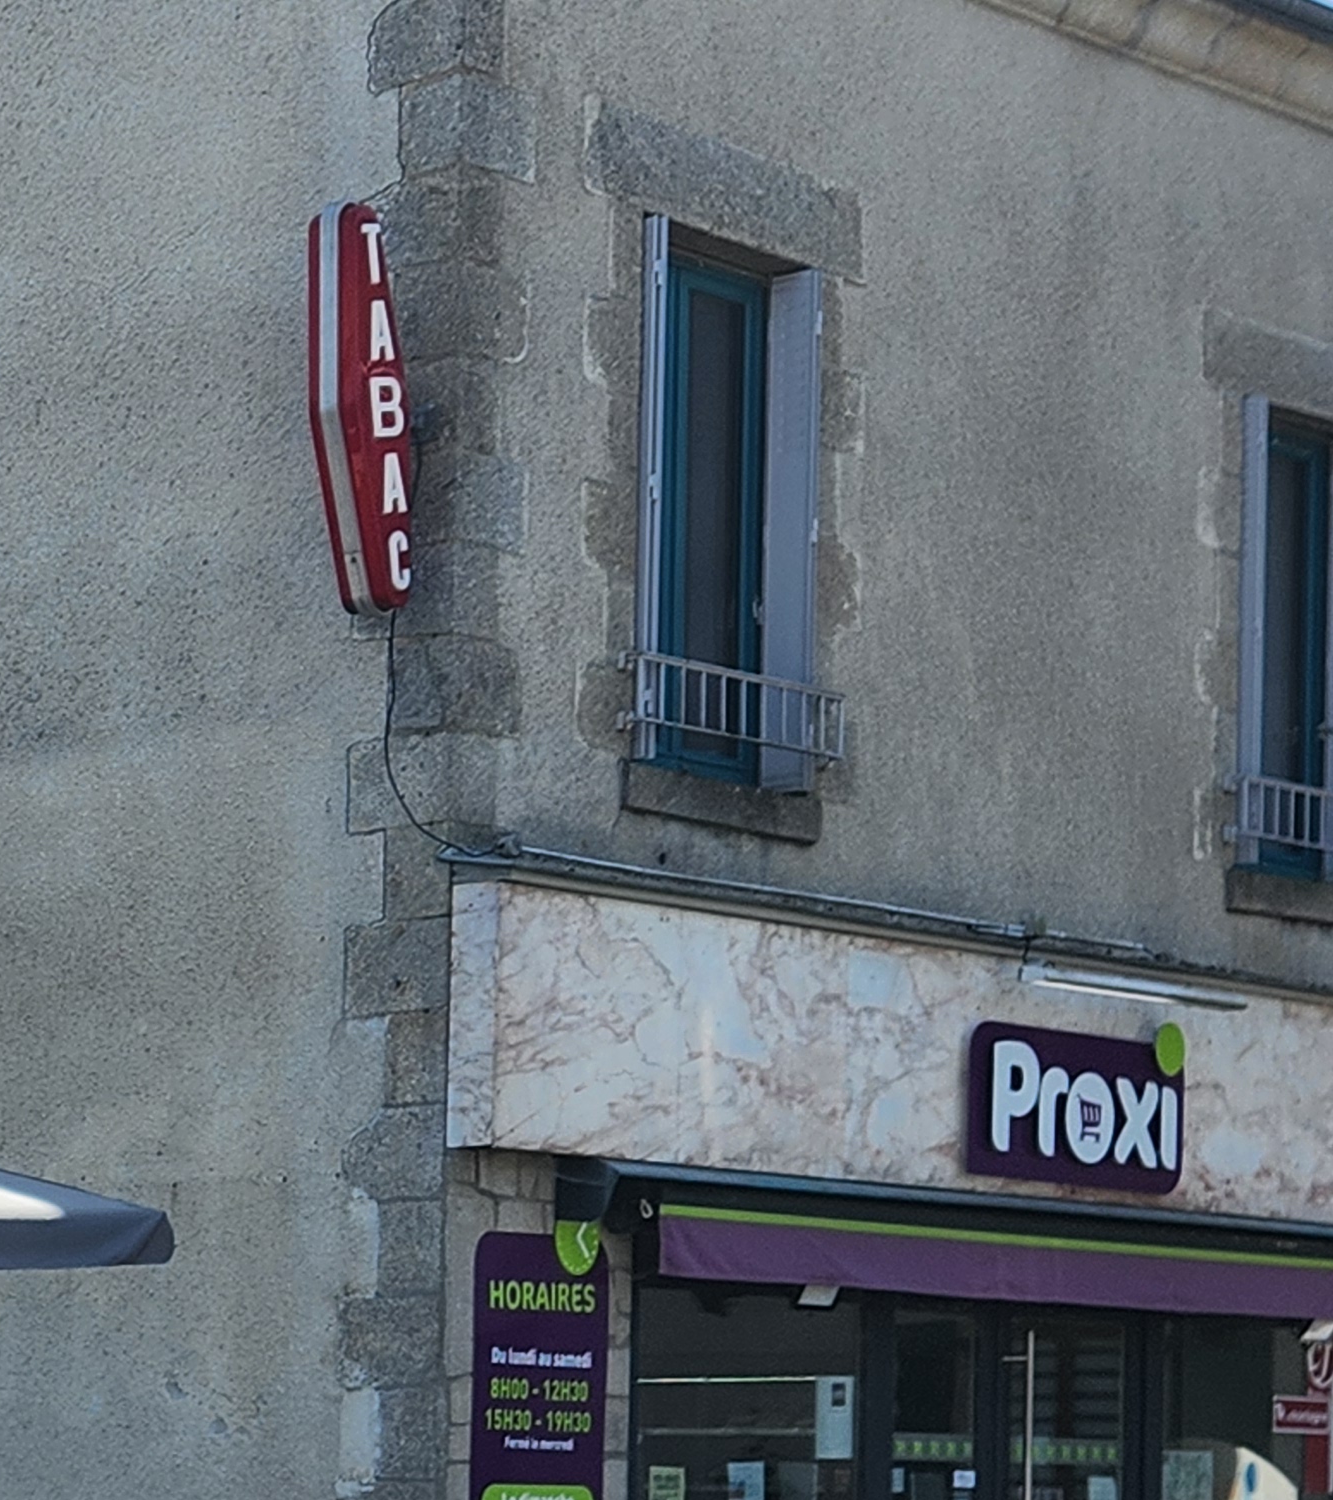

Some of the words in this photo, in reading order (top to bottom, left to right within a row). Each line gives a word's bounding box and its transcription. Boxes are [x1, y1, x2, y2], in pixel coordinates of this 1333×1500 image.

[360, 222, 412, 592] TABAC
[991, 1038, 1179, 1172] Proxi
[488, 1279, 596, 1314] HORAIRES
[490, 1346, 508, 1365] Du
[508, 1347, 537, 1366] lundi
[538, 1352, 552, 1368] au
[552, 1352, 593, 1369] samedi
[489, 1377, 530, 1400] 8H00
[542, 1378, 590, 1402] 12H30
[484, 1408, 532, 1431] 15H30
[545, 1409, 592, 1433] 19H30
